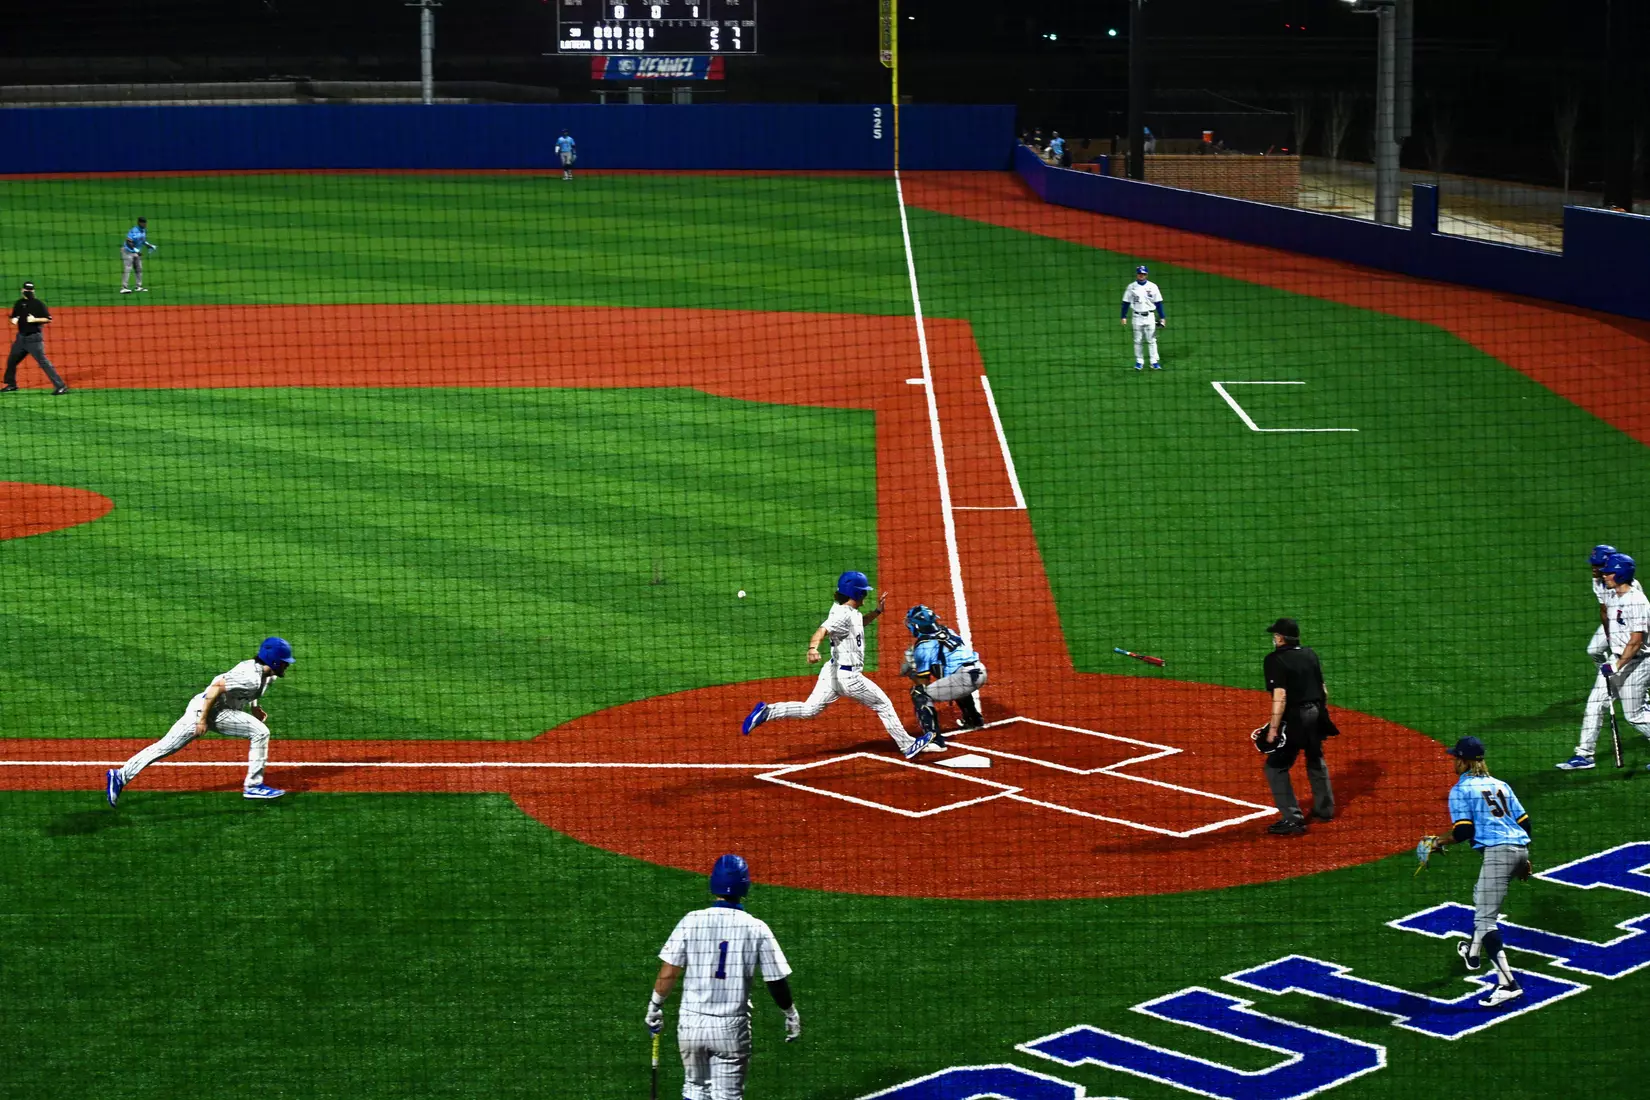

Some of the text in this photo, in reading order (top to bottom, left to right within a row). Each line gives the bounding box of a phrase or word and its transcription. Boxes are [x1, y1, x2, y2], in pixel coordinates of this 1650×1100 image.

[614, 5, 698, 18] 0 0 1
[710, 26, 720, 38] 2
[732, 26, 740, 38] 7
[710, 38, 720, 50] 5
[732, 38, 740, 50] 7
[873, 107, 882, 140] 325
[1480, 789, 1512, 818] 51
[714, 940, 728, 980] 1
